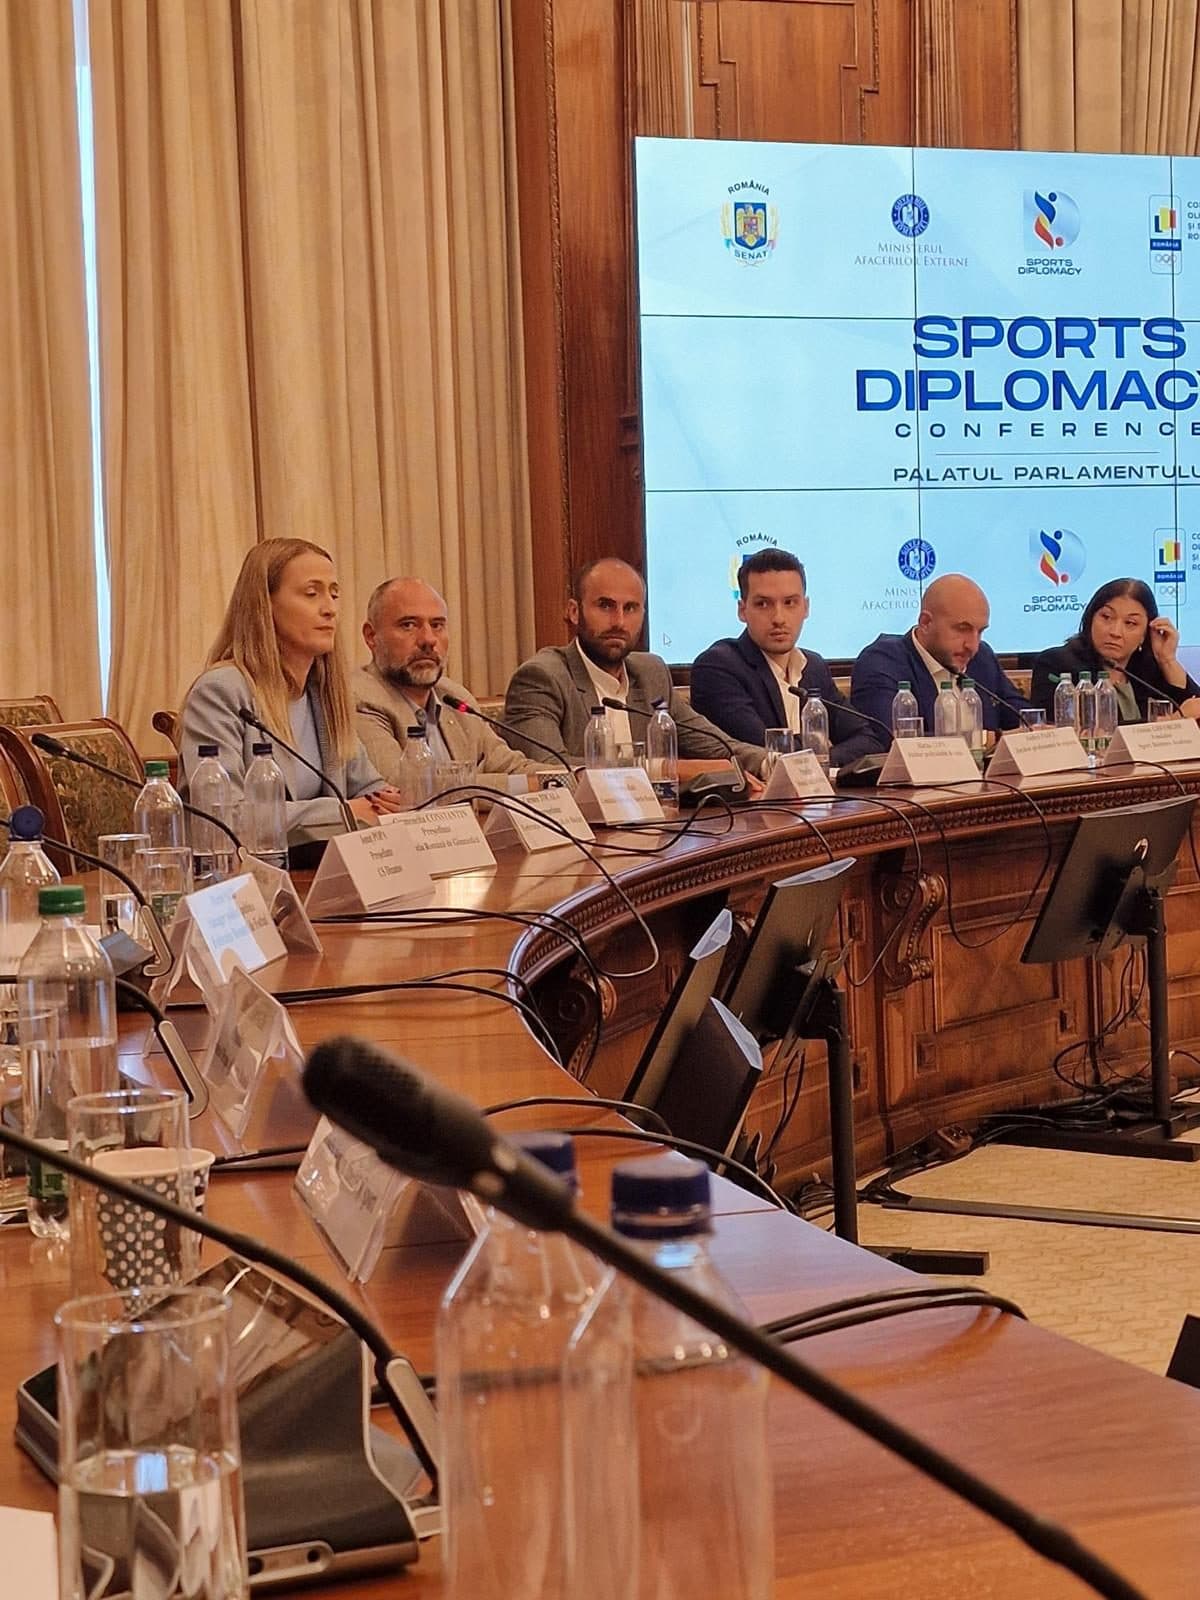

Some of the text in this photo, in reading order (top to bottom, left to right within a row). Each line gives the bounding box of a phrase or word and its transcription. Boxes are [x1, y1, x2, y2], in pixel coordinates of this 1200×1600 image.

[727, 179, 770, 196] ROMÂNIA
[734, 250, 769, 260] SENAT
[924, 256, 969, 267] EXTERNE
[1026, 258, 1073, 267] SPORTS
[1018, 267, 1082, 276] DIPLOMACY
[913, 315, 1187, 360] SPORTS
[856, 369, 1200, 412] DIPLOMAC
[894, 422, 1200, 438] CONFERENCE
[893, 467, 1003, 482] PALATUL
[736, 532, 778, 547] ROMÂNIA
[862, 600, 919, 610] AFACERILO
[1031, 595, 1078, 604] SPORTS
[1023, 603, 1087, 613] DIPLOMACY
